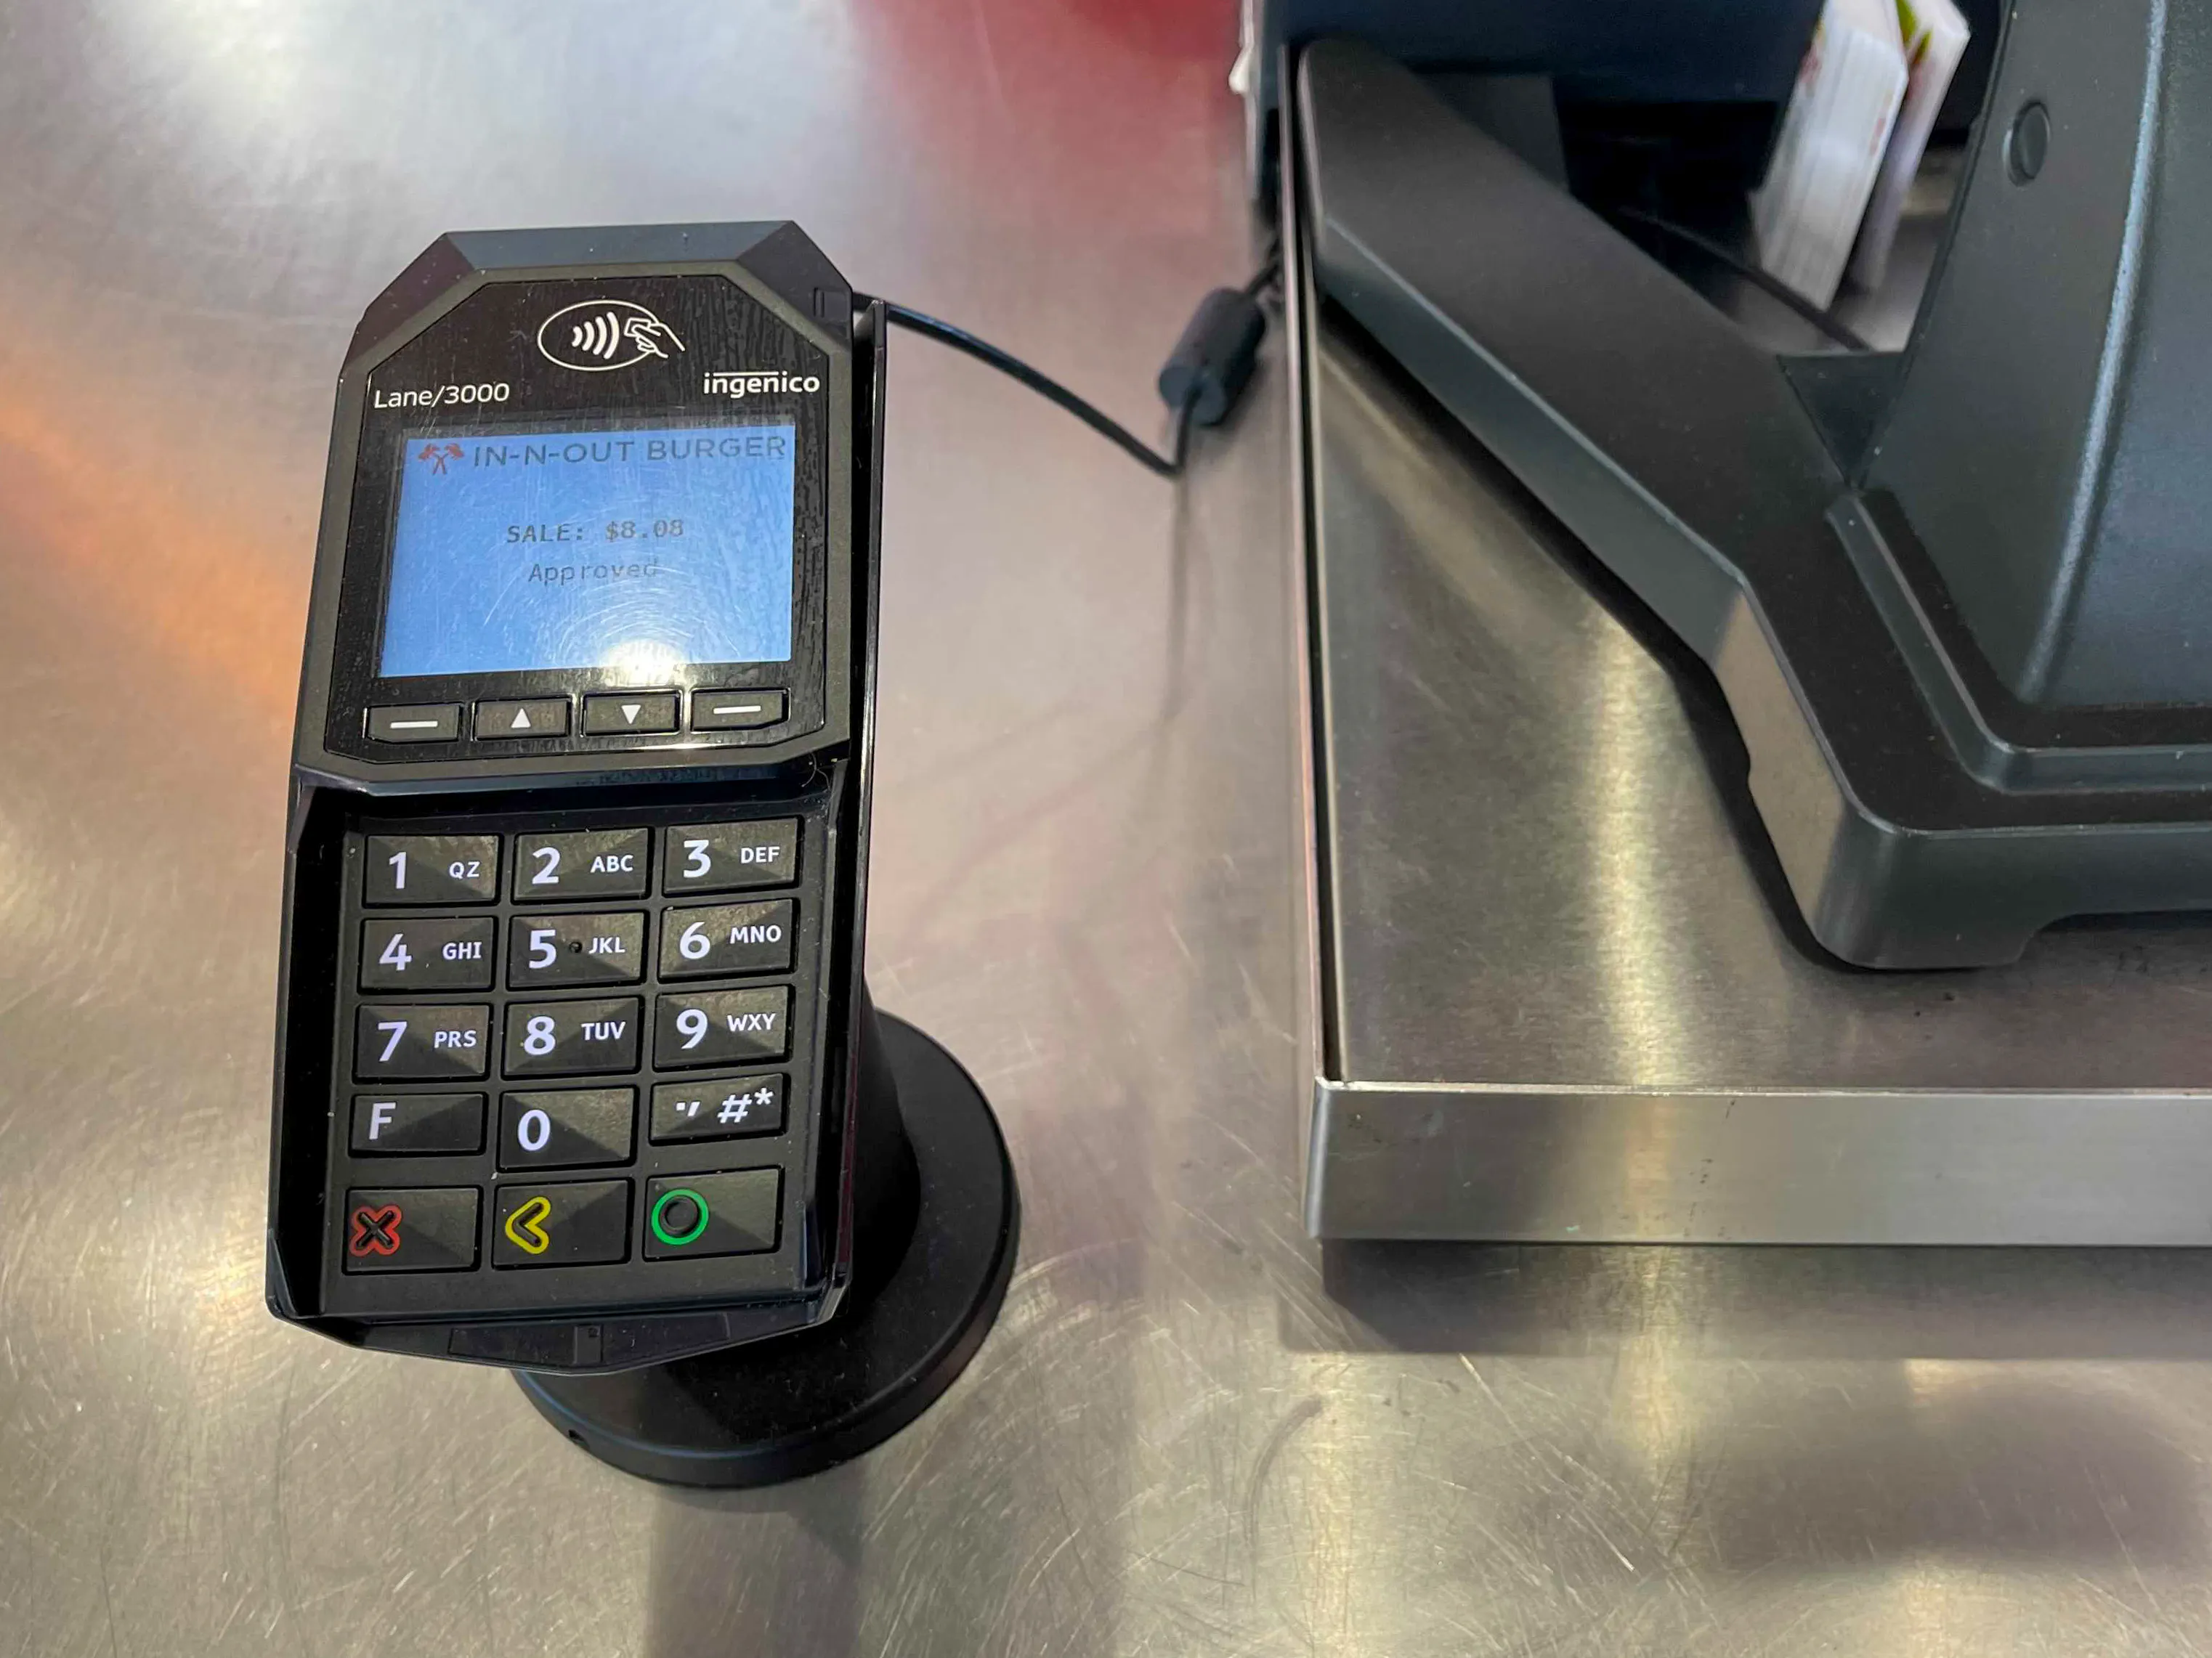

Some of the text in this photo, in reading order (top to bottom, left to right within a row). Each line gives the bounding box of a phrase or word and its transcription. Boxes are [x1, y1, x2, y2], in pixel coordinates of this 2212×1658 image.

[373, 383, 510, 409] Lane/3000
[703, 371, 820, 399] ingenico
[473, 436, 786, 467] IN-N-OUT BURGER
[506, 519, 684, 543] SALE: $8.08
[528, 561, 658, 583] Approved
[388, 851, 480, 890] 1 QZ
[531, 847, 633, 885] 2 ABC
[683, 839, 780, 878] 3 DEF
[379, 933, 482, 971] 4 GHI
[528, 930, 625, 969] 5 JKL
[679, 922, 782, 960] 6 MNO
[378, 1021, 477, 1062] 7 PRS
[523, 1015, 626, 1055] 8 TUV
[676, 1008, 777, 1049] 9 WXY
[368, 1102, 397, 1140] F
[516, 1108, 551, 1151] 0
